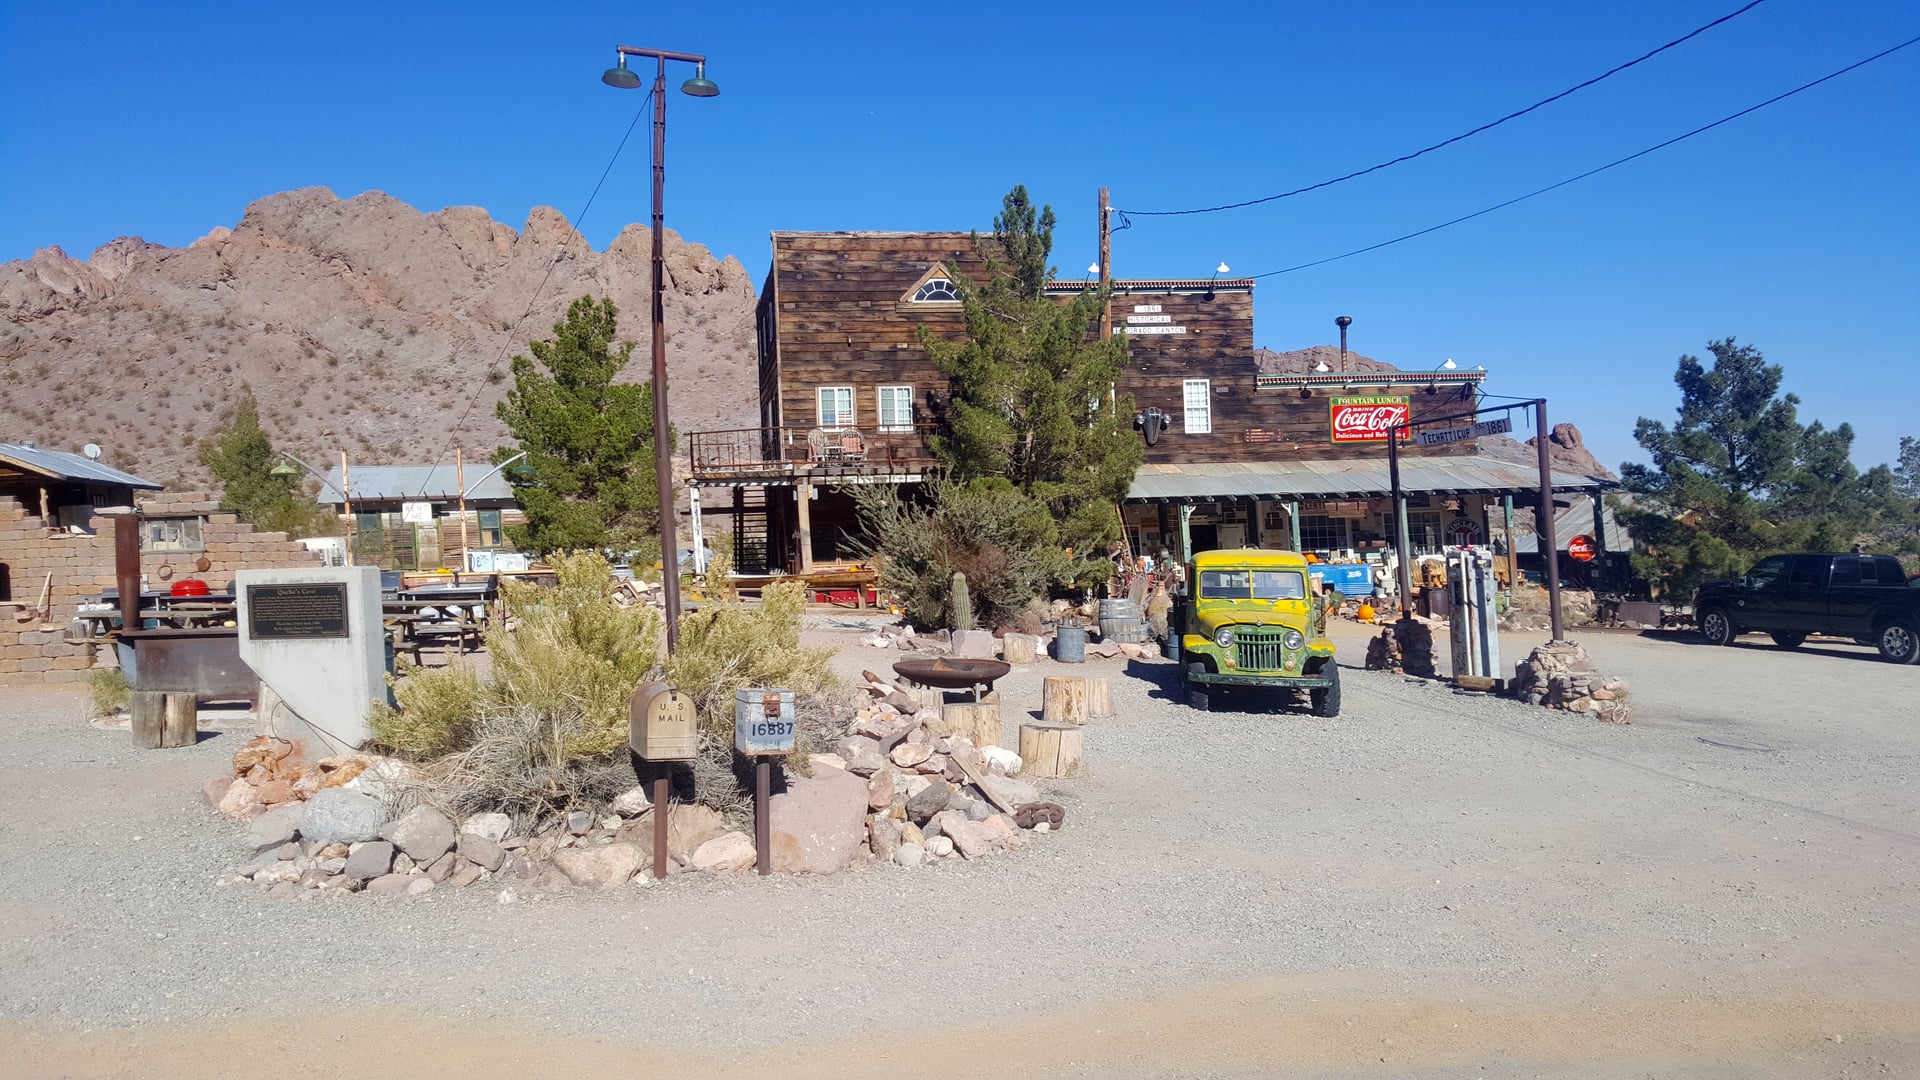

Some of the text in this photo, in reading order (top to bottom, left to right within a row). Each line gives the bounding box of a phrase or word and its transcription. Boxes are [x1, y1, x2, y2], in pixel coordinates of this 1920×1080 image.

[1338, 397, 1402, 405] FOUNTAIN LUNCH
[1335, 406, 1407, 432] Coca-Cola
[1486, 419, 1508, 435] 1861
[1363, 431, 1374, 439] and
[658, 714, 685, 722] MAIL
[752, 722, 794, 737] 16887
